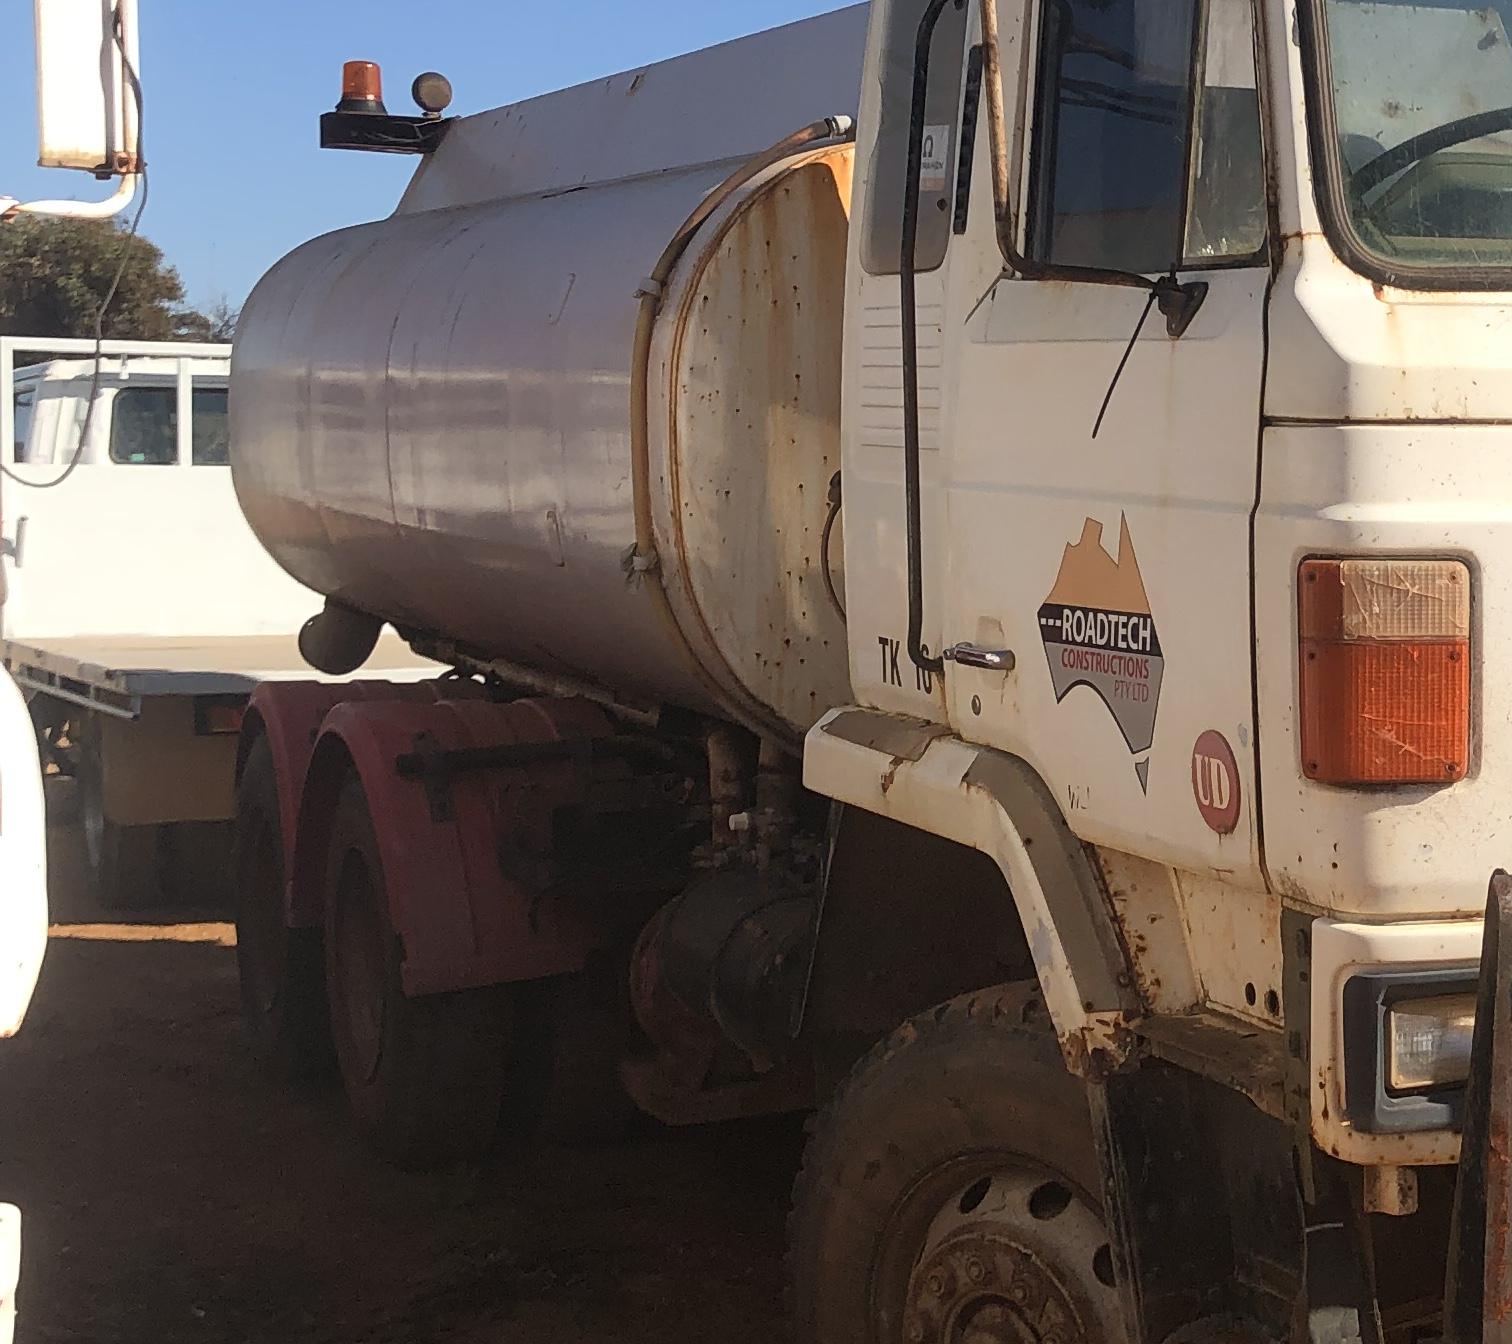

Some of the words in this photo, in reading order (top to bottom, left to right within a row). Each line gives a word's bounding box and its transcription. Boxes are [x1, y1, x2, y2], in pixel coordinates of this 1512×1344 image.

[1062, 608, 1152, 652] ROADTECH
[878, 636, 903, 688] TK
[1061, 648, 1149, 680] CONSTRUCTIONS
[1114, 679, 1131, 700] PTY
[1132, 683, 1149, 703] LTD
[1194, 753, 1231, 810] UD
